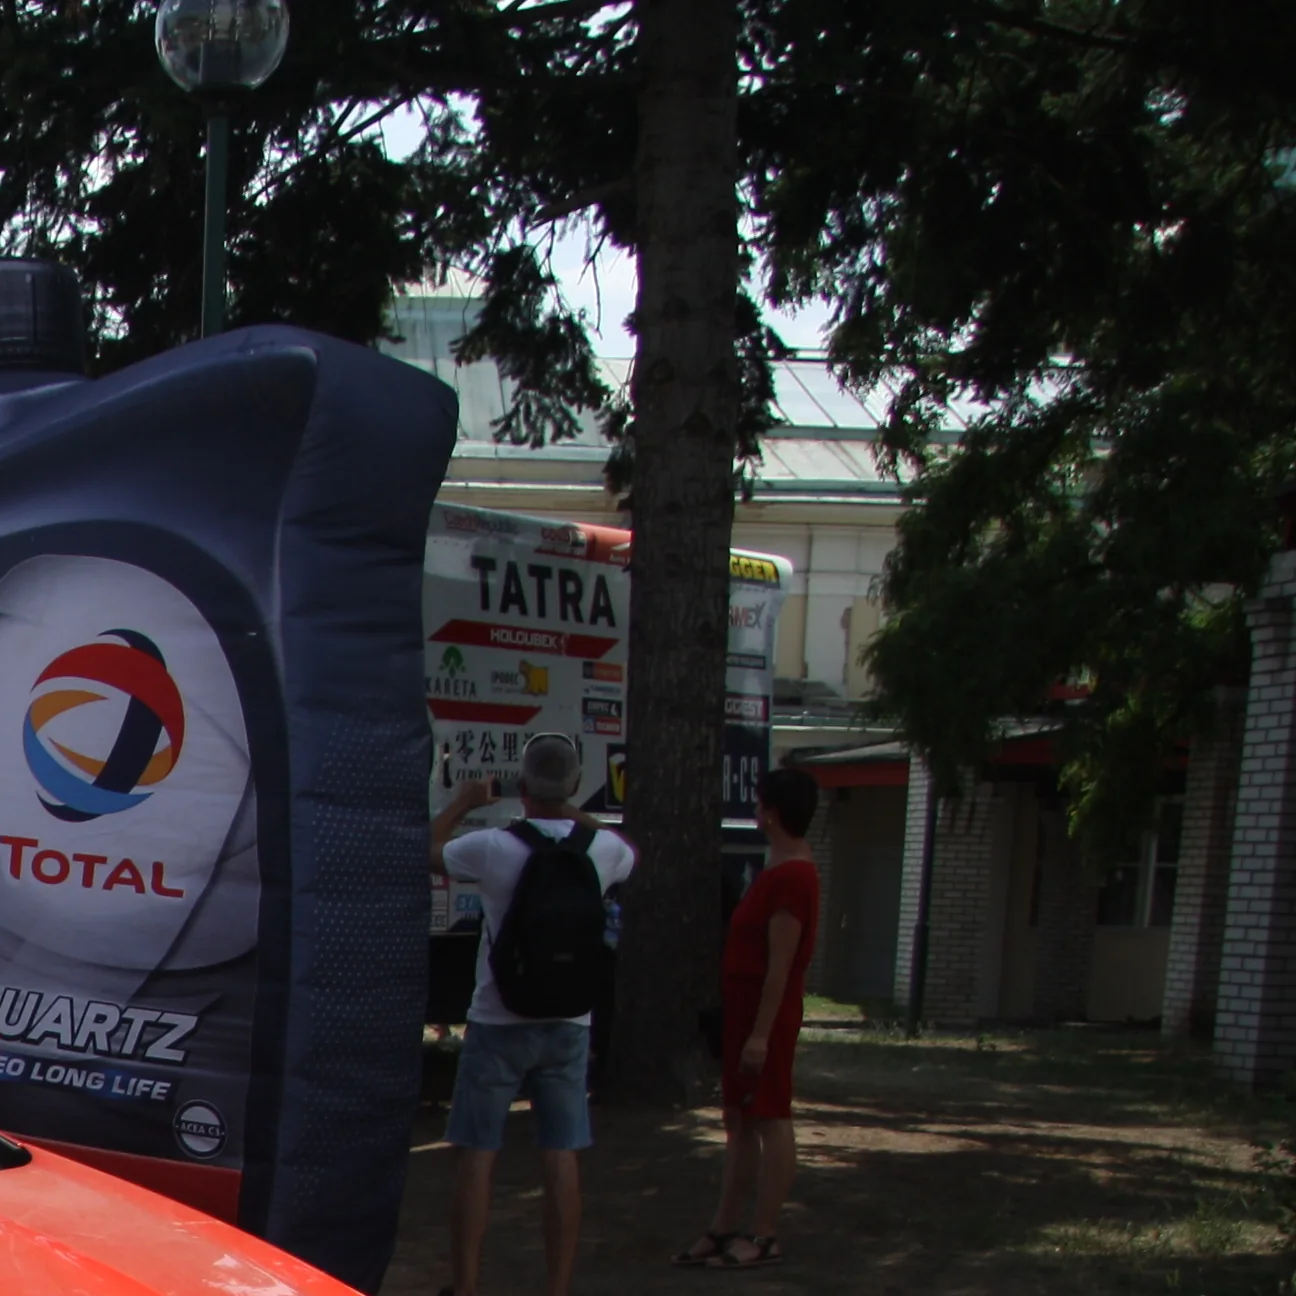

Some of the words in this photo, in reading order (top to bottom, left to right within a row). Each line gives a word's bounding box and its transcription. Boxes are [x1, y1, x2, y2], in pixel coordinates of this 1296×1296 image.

[470, 554, 617, 628] TATRA
[490, 628, 558, 649] HOLOUBEK
[30, 1060, 105, 1091] LONG
[110, 1074, 172, 1101] LIFE
[180, 1121, 206, 1135] ACEA
